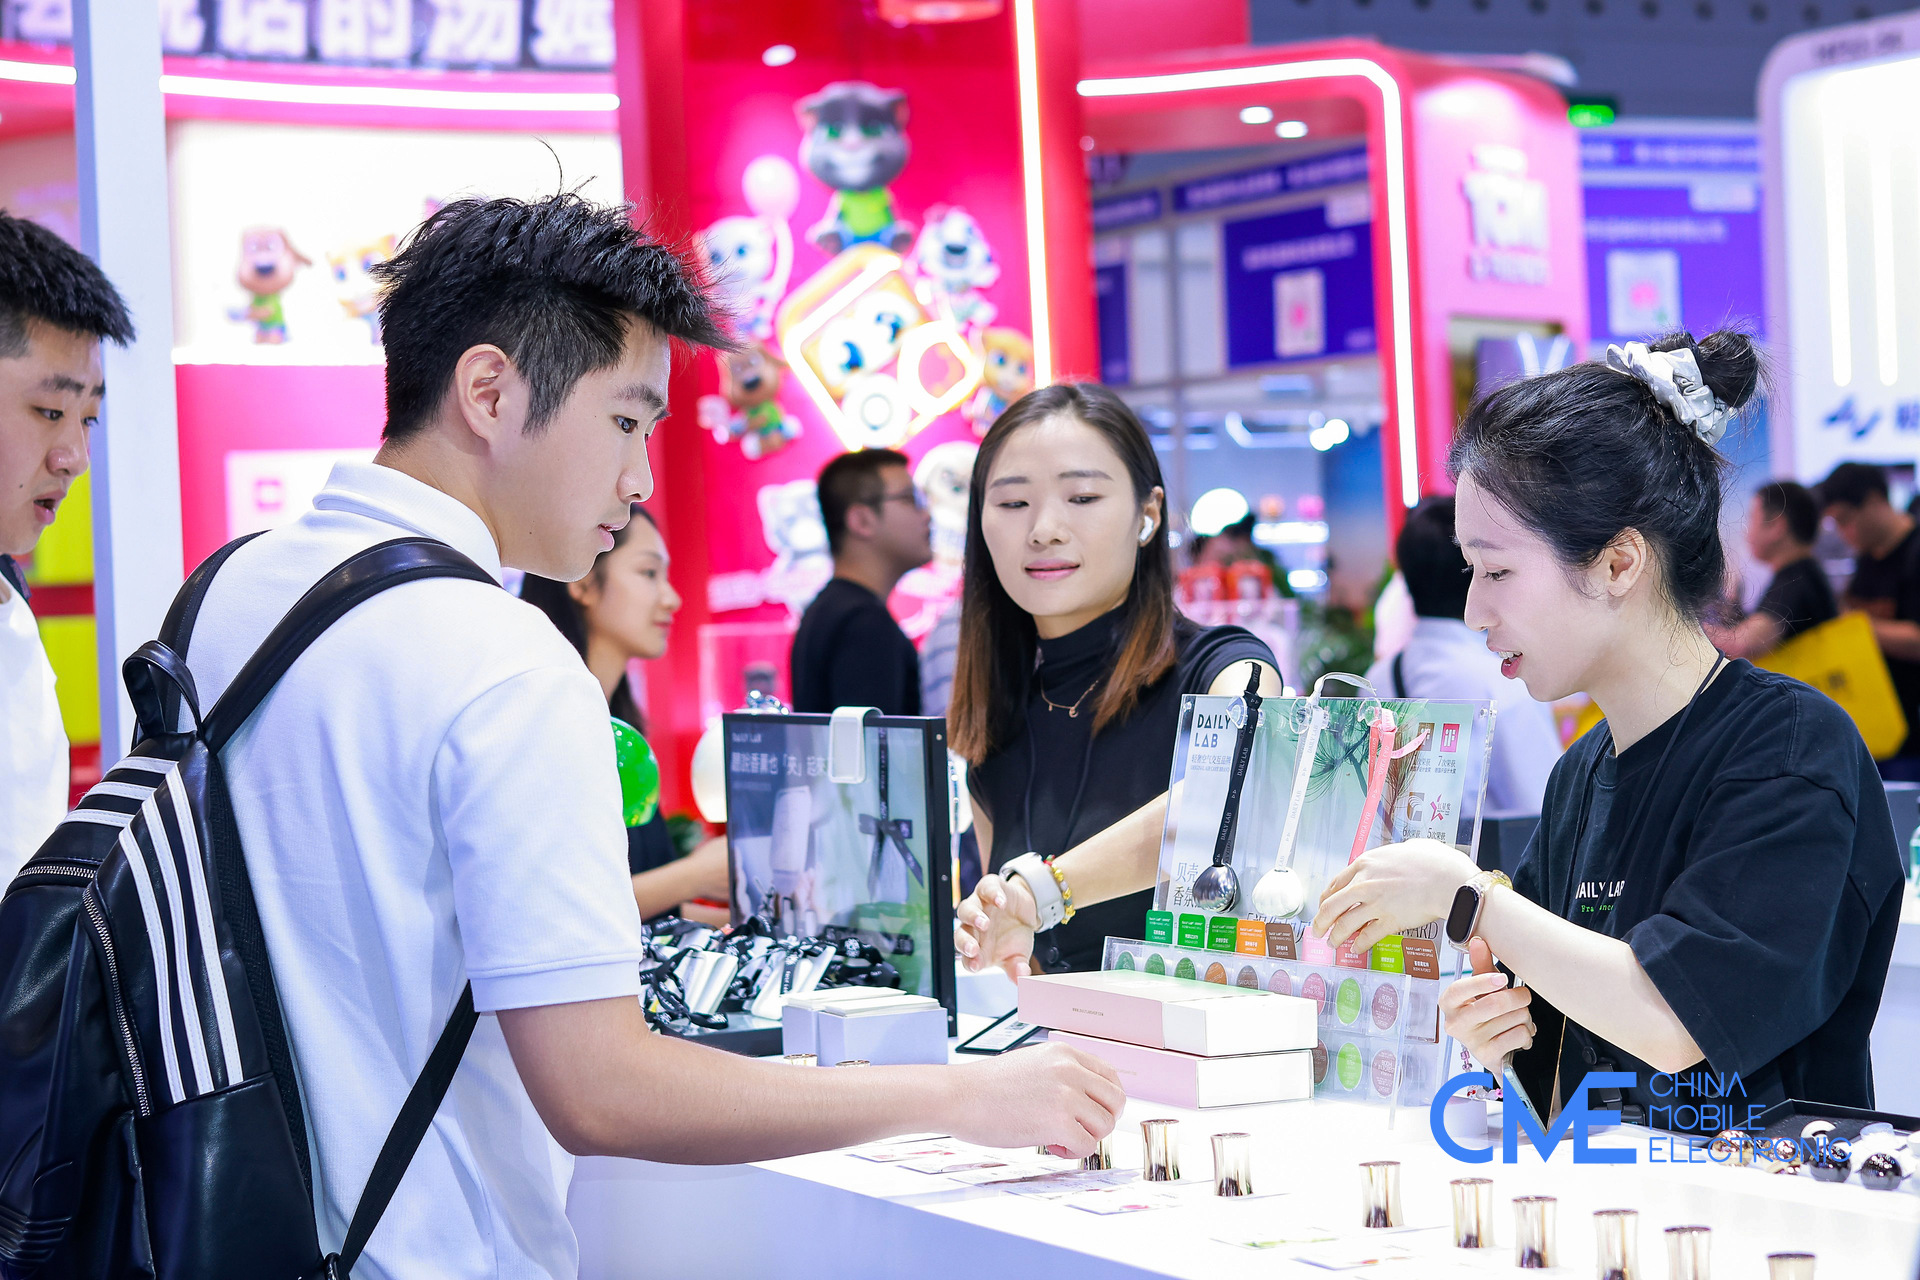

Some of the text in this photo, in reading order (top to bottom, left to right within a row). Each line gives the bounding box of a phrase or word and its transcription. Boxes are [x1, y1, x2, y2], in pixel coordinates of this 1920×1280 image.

[1197, 714, 1231, 729] DAILY
[1195, 733, 1218, 748] LAB
[1237, 758, 1246, 776] DAILY
[1220, 824, 1229, 841] DAILY
[1175, 862, 1199, 882] 贝壳
[1173, 885, 1200, 908] 香氛
